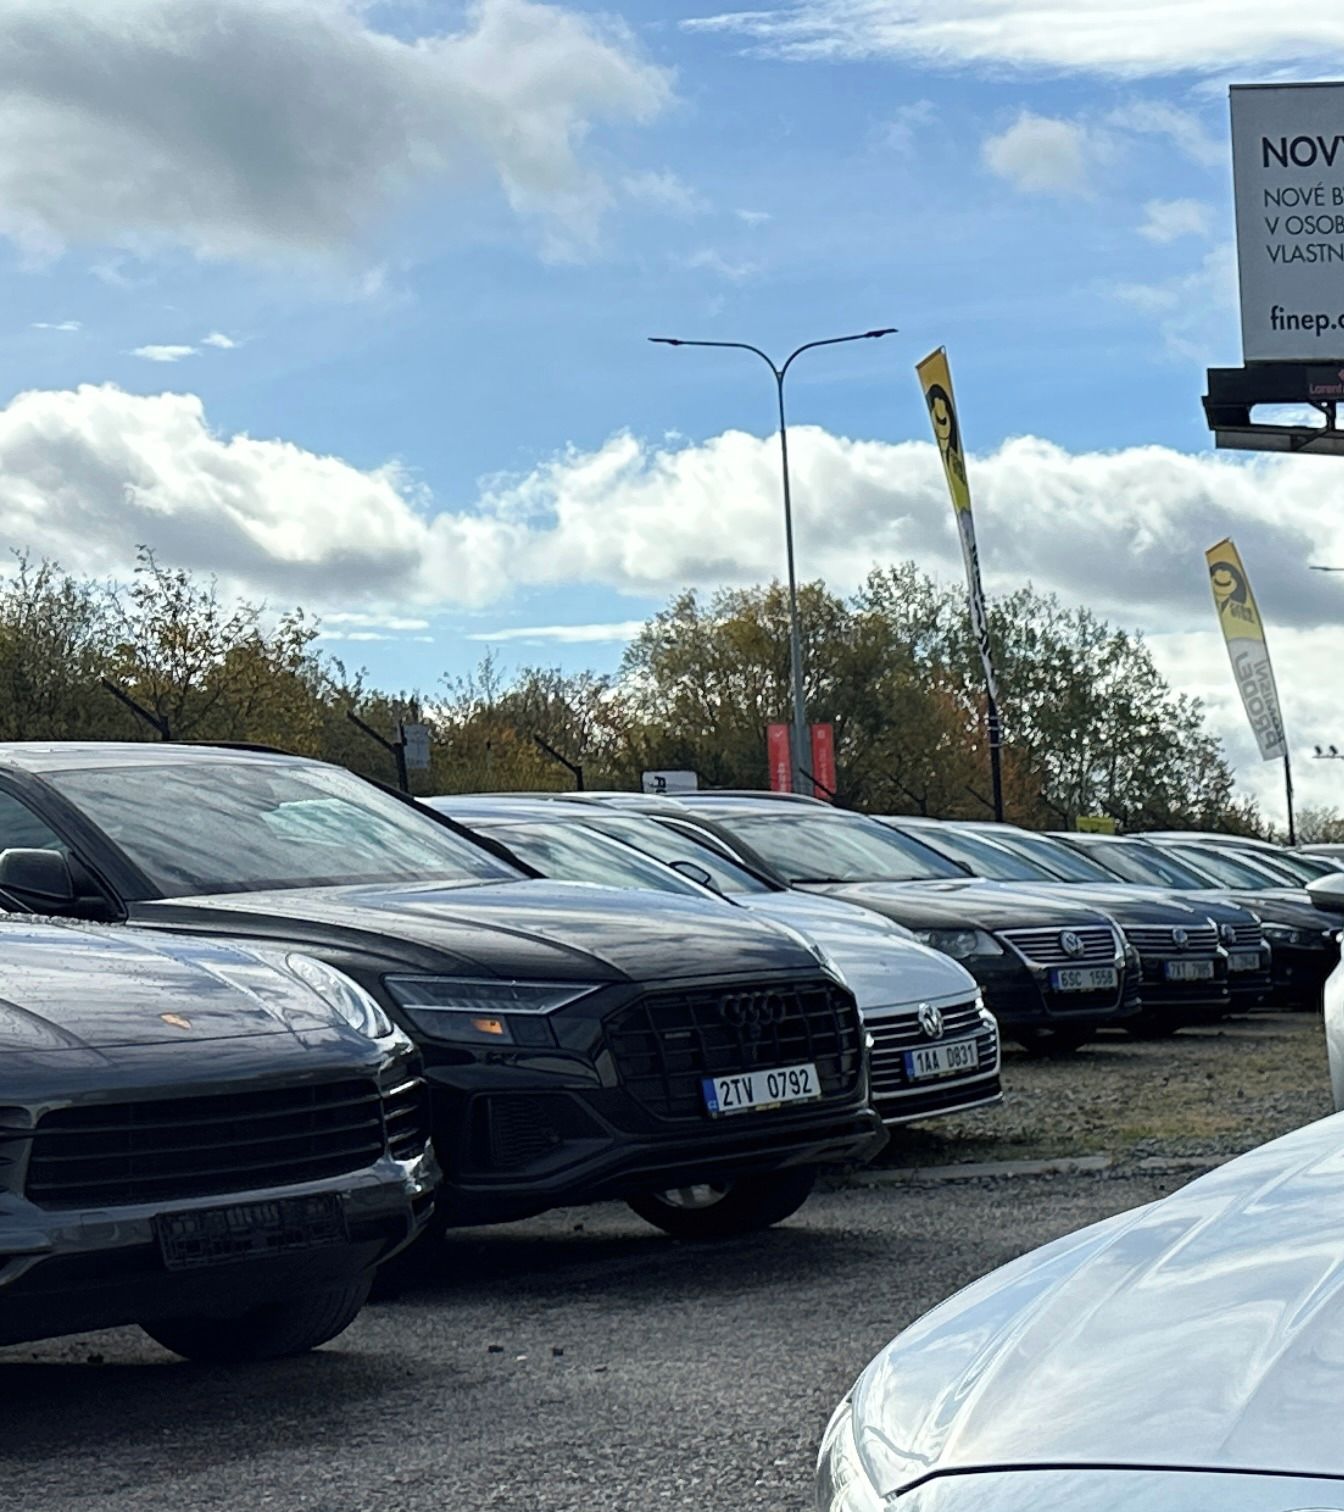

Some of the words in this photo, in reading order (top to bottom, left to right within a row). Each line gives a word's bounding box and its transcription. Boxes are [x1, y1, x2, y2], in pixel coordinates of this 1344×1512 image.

[1264, 182, 1326, 208] NOVÉ
[1264, 217, 1280, 235] V
[720, 1076, 754, 1107] 2TV
[766, 1069, 812, 1099] 0792
